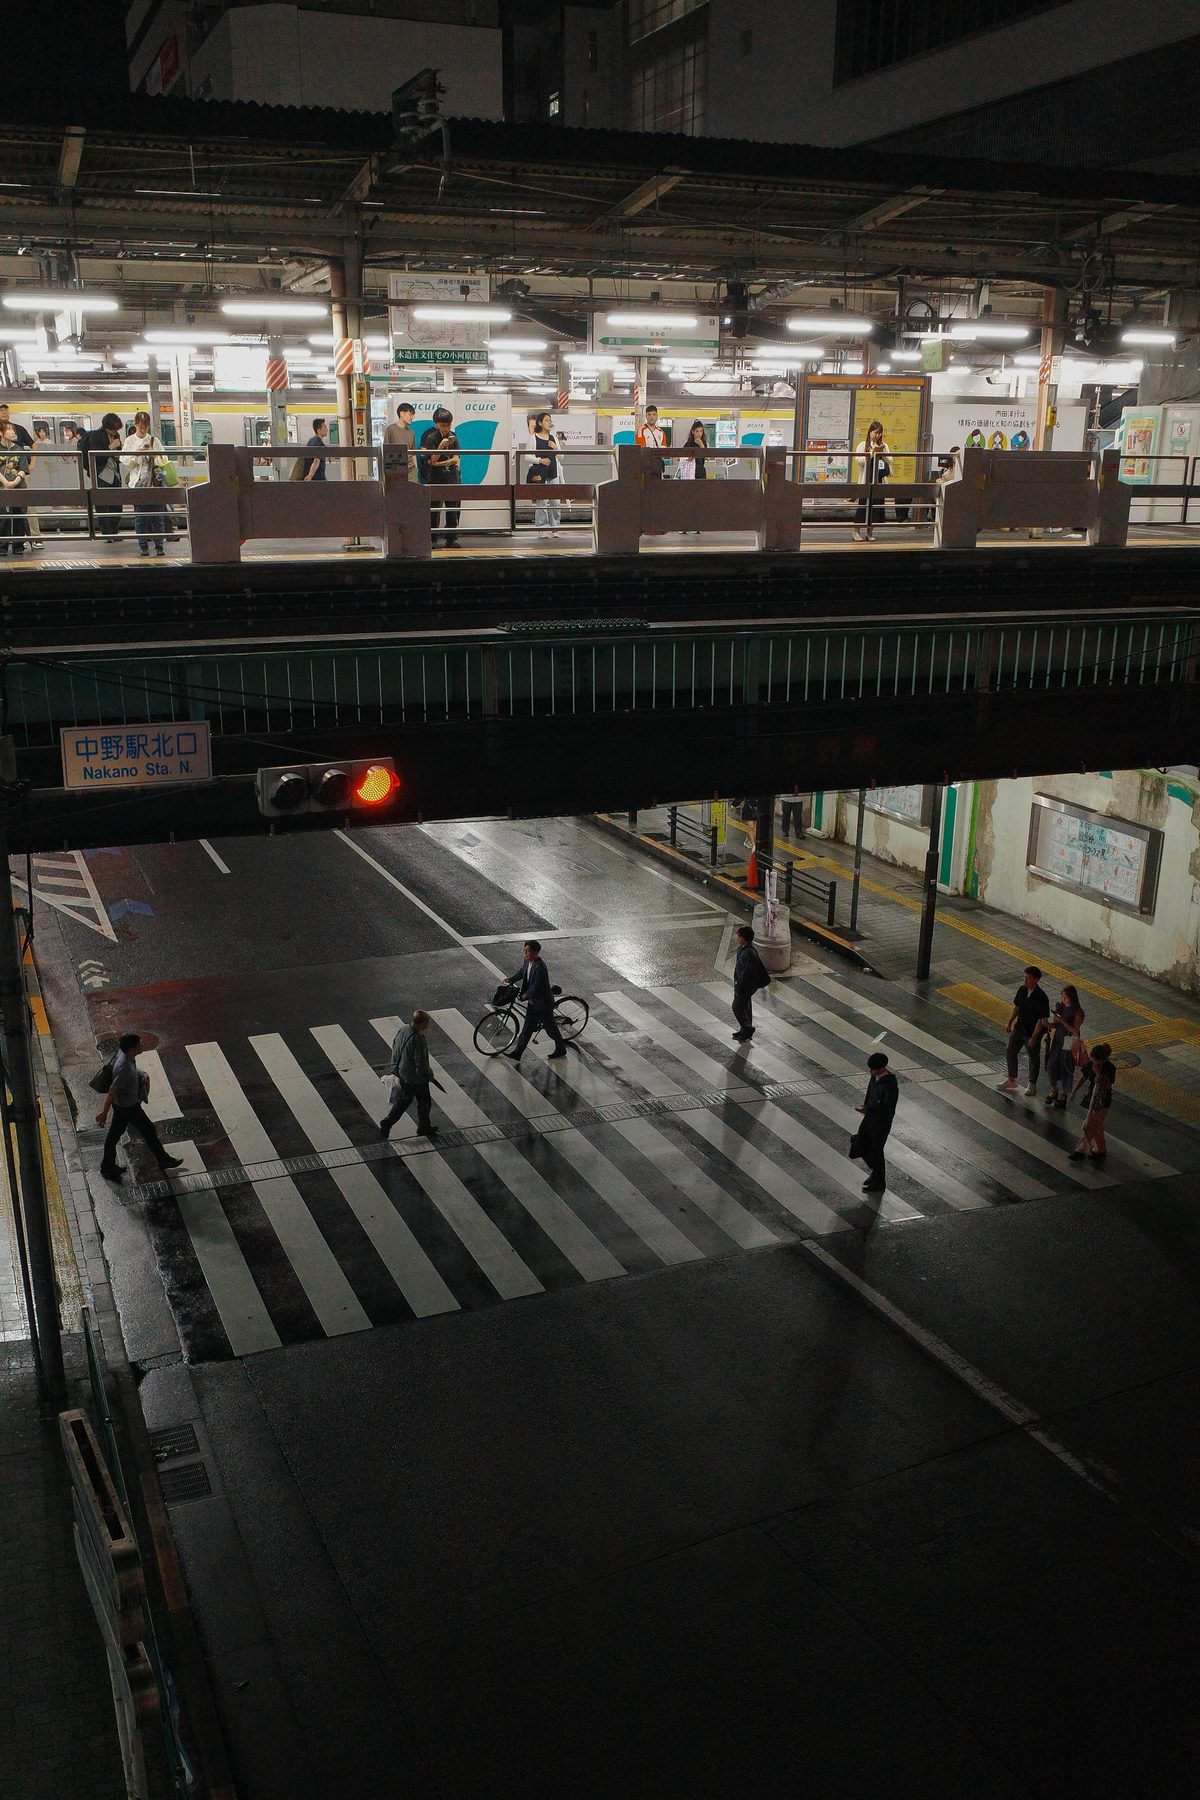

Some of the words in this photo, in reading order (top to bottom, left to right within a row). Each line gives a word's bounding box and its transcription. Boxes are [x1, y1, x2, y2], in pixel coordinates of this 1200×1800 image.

[465, 402, 497, 411] acure
[995, 410, 1026, 418] 内田洋行は
[75, 731, 198, 763] 中野駅北口
[83, 765, 139, 781] Nakano
[145, 762, 173, 777] Sta.
[179, 760, 193, 775] N.
